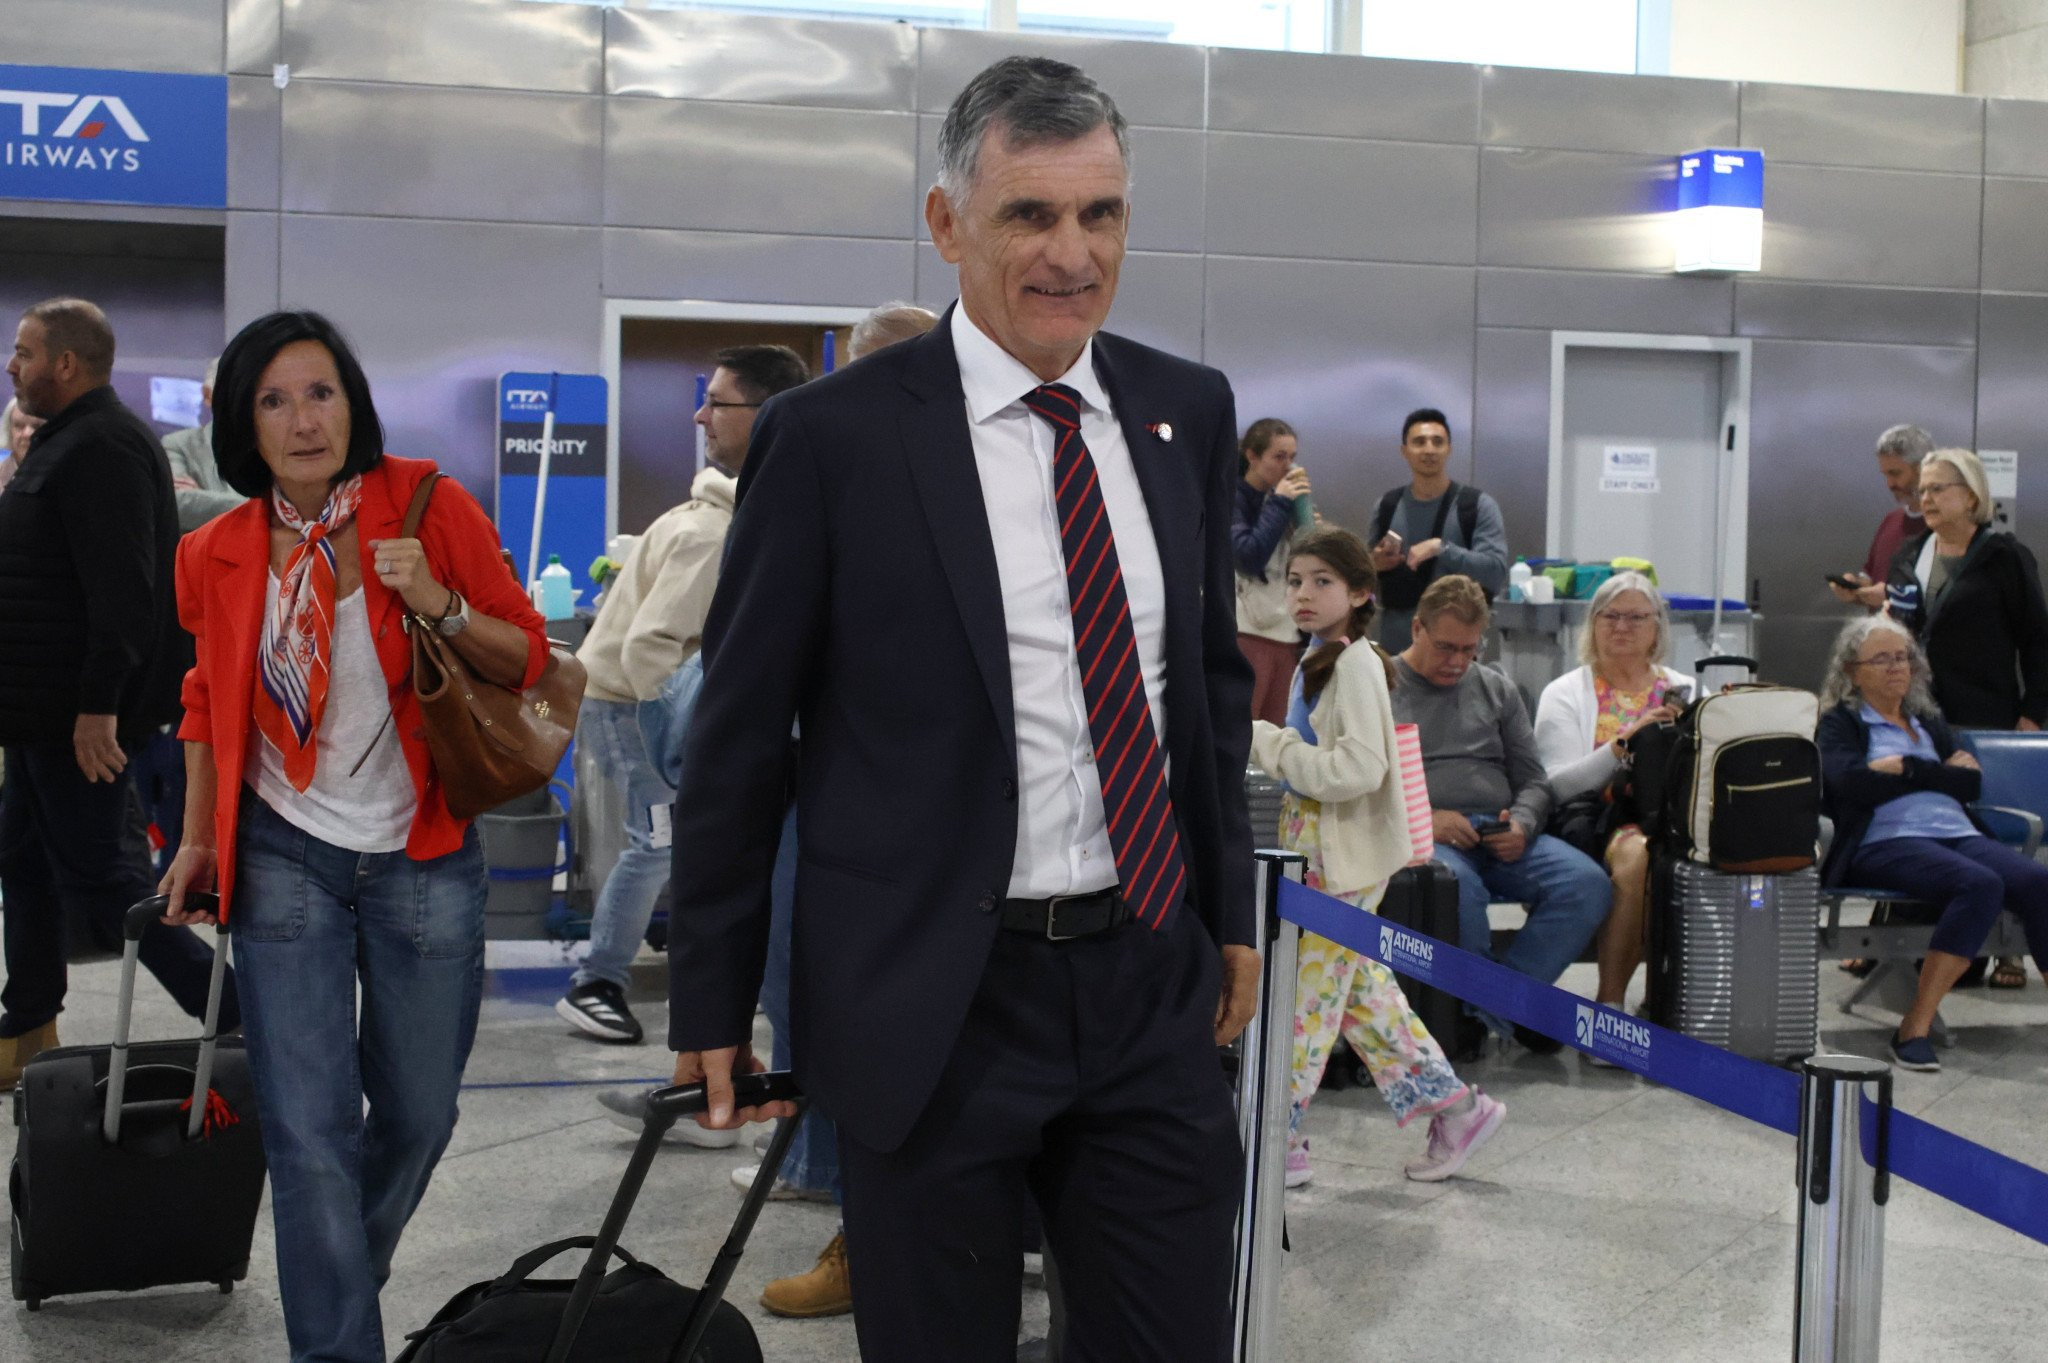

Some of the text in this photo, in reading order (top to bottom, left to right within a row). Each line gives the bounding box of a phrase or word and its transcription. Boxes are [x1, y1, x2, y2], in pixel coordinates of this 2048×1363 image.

[0, 90, 150, 142] TA
[6, 142, 140, 172] IRWAYS
[506, 389, 549, 403] ITA
[505, 438, 588, 455] PRIORITY
[1393, 931, 1433, 962] ATHENS
[1595, 1011, 1651, 1049] ATHENS
